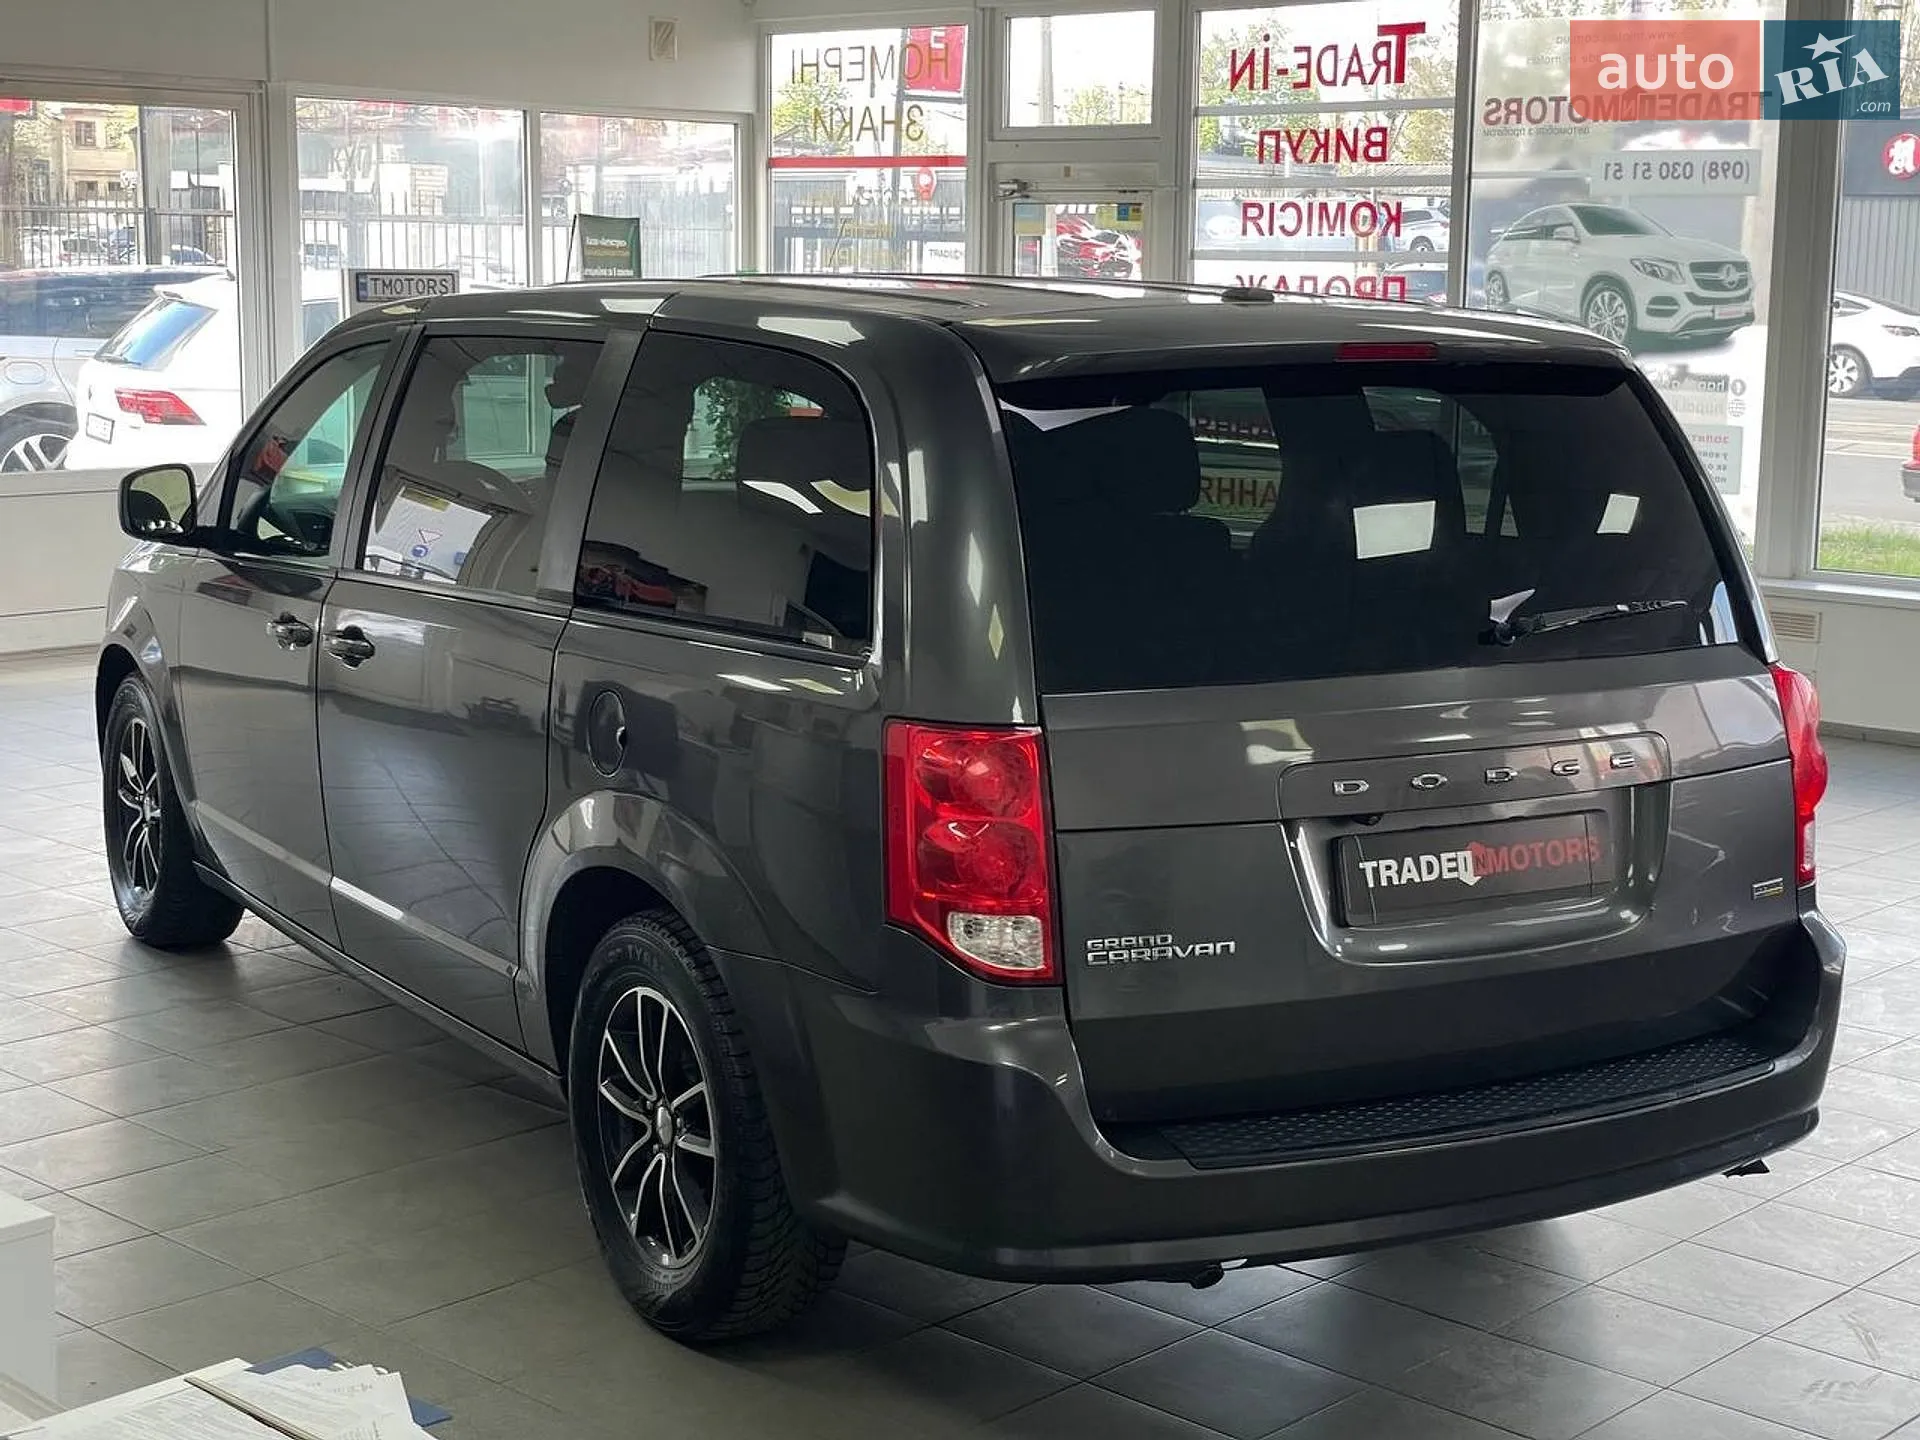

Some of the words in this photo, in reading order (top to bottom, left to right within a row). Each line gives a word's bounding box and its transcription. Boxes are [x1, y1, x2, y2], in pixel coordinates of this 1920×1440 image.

[370, 277, 449, 296] TMOTORS
[1333, 751, 1637, 796] DODGE
[1086, 934, 1173, 951] GRAND
[1086, 940, 1236, 967] CARAVAN
